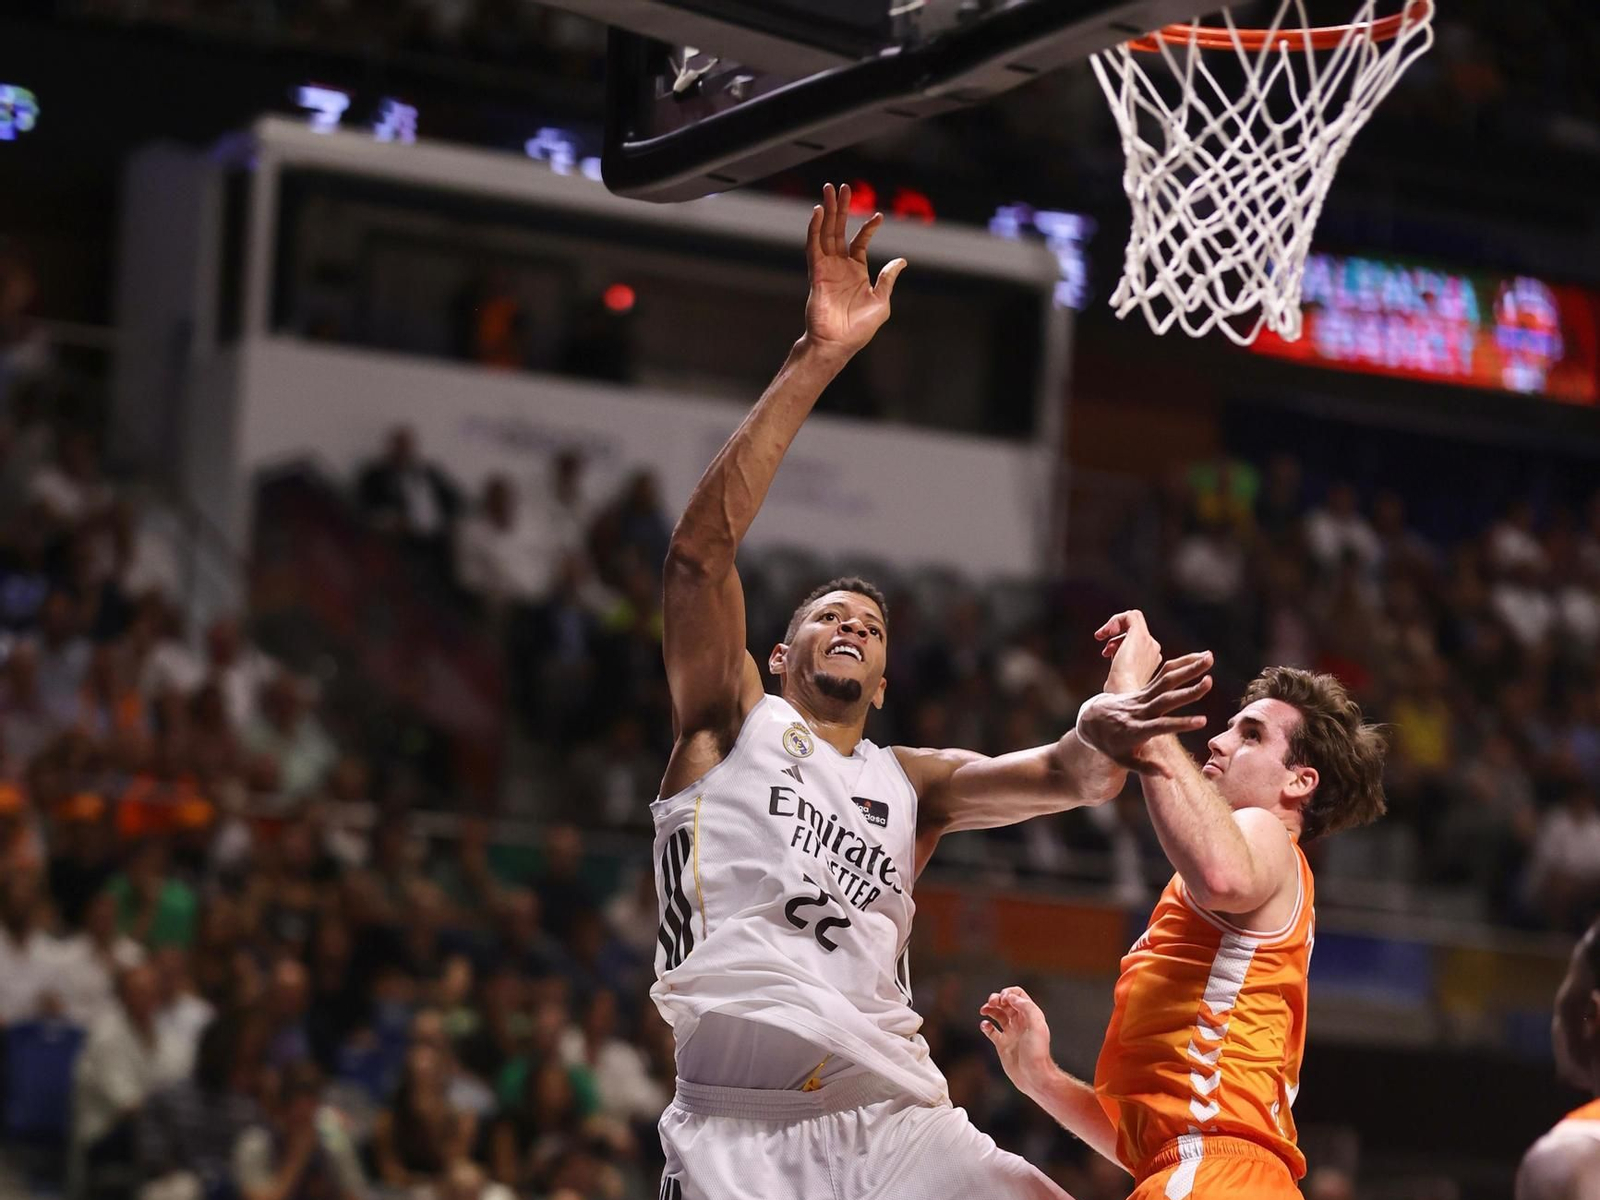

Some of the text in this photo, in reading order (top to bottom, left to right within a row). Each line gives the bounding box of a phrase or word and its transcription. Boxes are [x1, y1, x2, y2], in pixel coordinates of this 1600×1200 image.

[790, 825, 881, 912] FLY ETTER
[784, 873, 852, 952] 22
